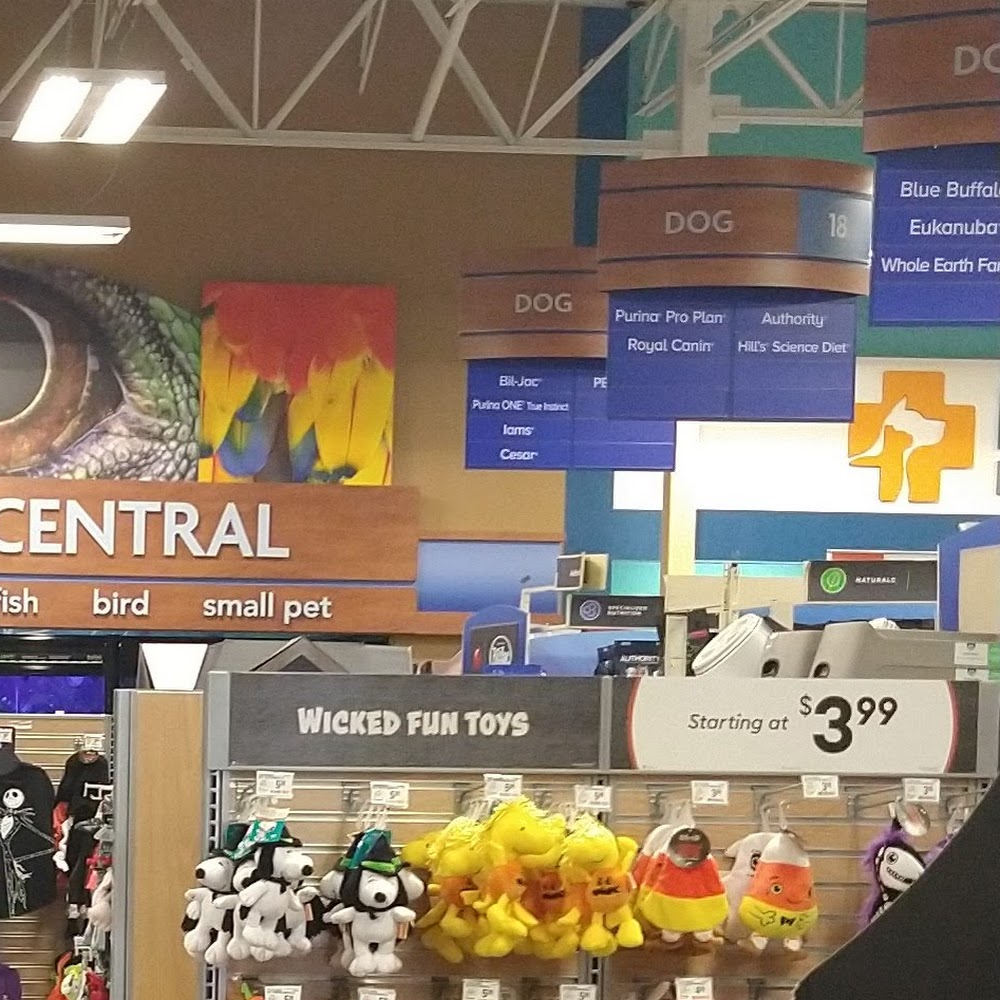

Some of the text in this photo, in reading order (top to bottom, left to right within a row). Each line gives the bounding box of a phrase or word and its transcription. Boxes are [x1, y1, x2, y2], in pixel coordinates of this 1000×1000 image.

[900, 181, 1000, 198] Blue Buffal
[665, 210, 735, 234] DOG
[828, 212, 848, 238] 18
[910, 219, 998, 235] Eukanuba
[881, 258, 930, 272] Whole
[934, 258, 974, 272] Earth
[515, 293, 573, 313] DOG
[615, 309, 723, 324] Purina Pro Plan
[761, 311, 824, 328] Authority
[628, 338, 712, 354] Royal Canin
[738, 341, 847, 353] Hill's Science Diet
[499, 376, 540, 387] Bil-Jac
[472, 400, 500, 410] Purina
[501, 400, 523, 411] ONE
[503, 424, 532, 436] Iams
[500, 449, 537, 461] Cesar
[855, 576, 897, 585] NATURALS
[93, 590, 149, 616] bird
[203, 590, 332, 624] small pet
[298, 706, 531, 737] WICKED FUN TOYS
[688, 713, 790, 734] Starting at
